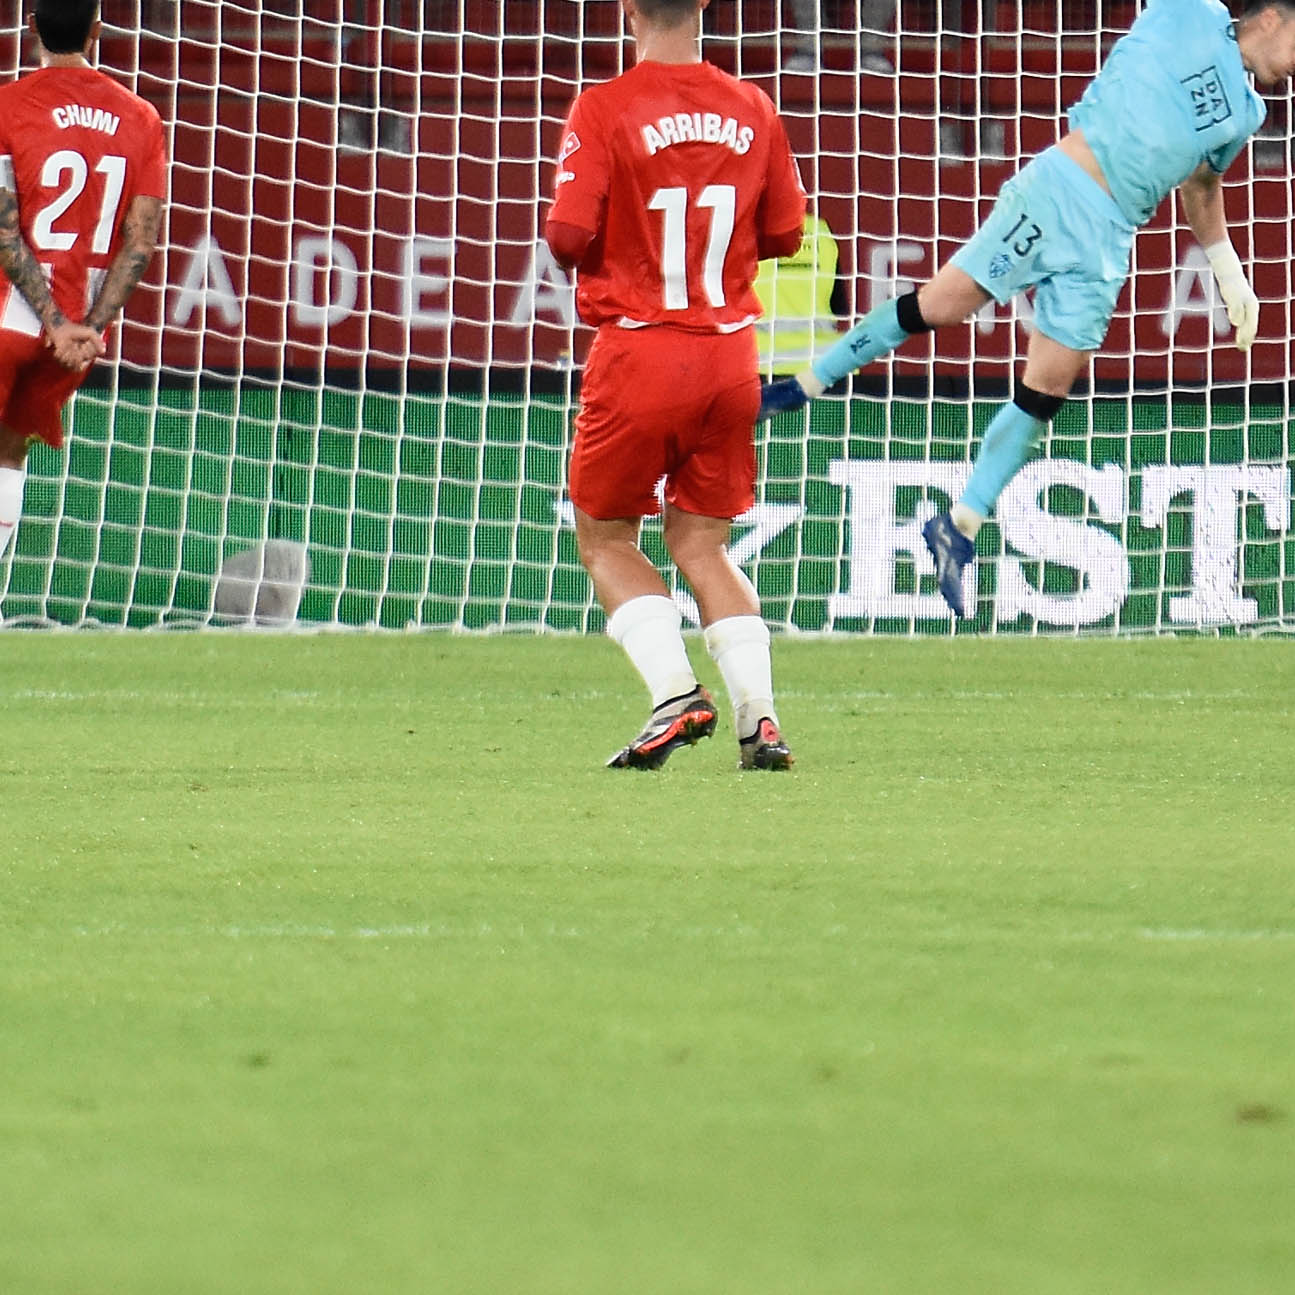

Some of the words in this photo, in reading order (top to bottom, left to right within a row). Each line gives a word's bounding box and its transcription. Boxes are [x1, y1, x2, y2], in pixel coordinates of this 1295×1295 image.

[52, 104, 120, 136] CHUMI
[642, 113, 754, 155] ARRIBAS
[32, 150, 127, 254] 21
[647, 185, 737, 311] 11
[1002, 213, 1042, 257] 13
